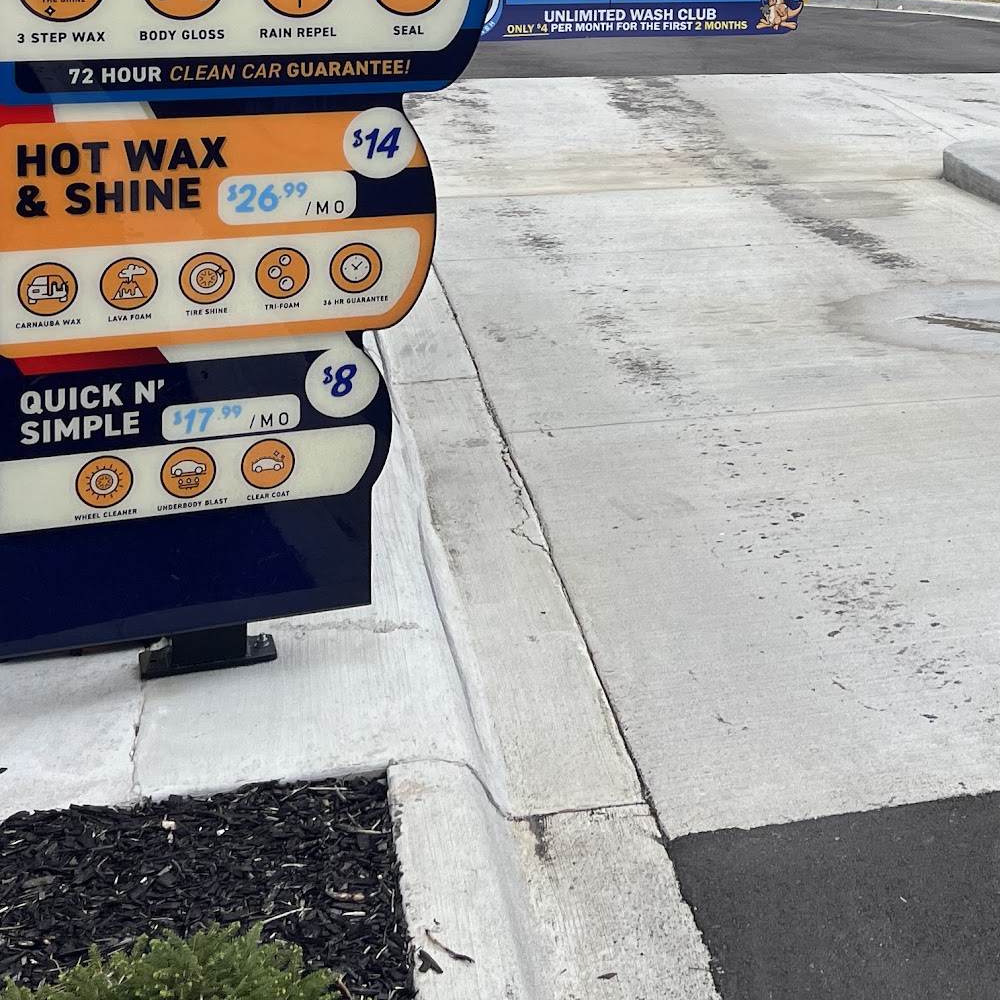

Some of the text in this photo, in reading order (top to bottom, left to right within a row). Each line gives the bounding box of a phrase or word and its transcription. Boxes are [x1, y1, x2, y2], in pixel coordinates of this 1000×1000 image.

[544, 7, 717, 23] UNLIMITED WASH CLUB
[259, 26, 337, 39] RAIN REPEL
[393, 24, 425, 36] SEAL
[506, 20, 748, 34] ONLY $4 PER MONTH FOR THE FIRST 2 MONTHS
[17, 31, 106, 44] 3 STEP WAX
[139, 28, 225, 41] BODY GLOSS
[68, 59, 411, 85] 72 HOUR CLEAN CAR GUARANTEE!
[352, 126, 402, 160] $14
[16, 136, 228, 177] HOT WAX
[15, 177, 203, 218] & SHINE
[226, 181, 308, 214] $26.99
[264, 301, 300, 310] TRI-FOAM
[323, 295, 389, 307] 36 HR GUARANTEE
[107, 313, 152, 323] LAVA FOAM
[185, 307, 229, 317] TIRE SHINE
[15, 318, 82, 330] CARNAUBA WAX
[323, 363, 358, 398] $8
[19, 378, 165, 415] QUICK N'
[19, 410, 140, 446] SIMPLE
[246, 490, 291, 502] CLEAR COAT
[156, 497, 228, 512] UNDERBODY BLAST
[74, 508, 138, 521] WHEEL CLEANER
